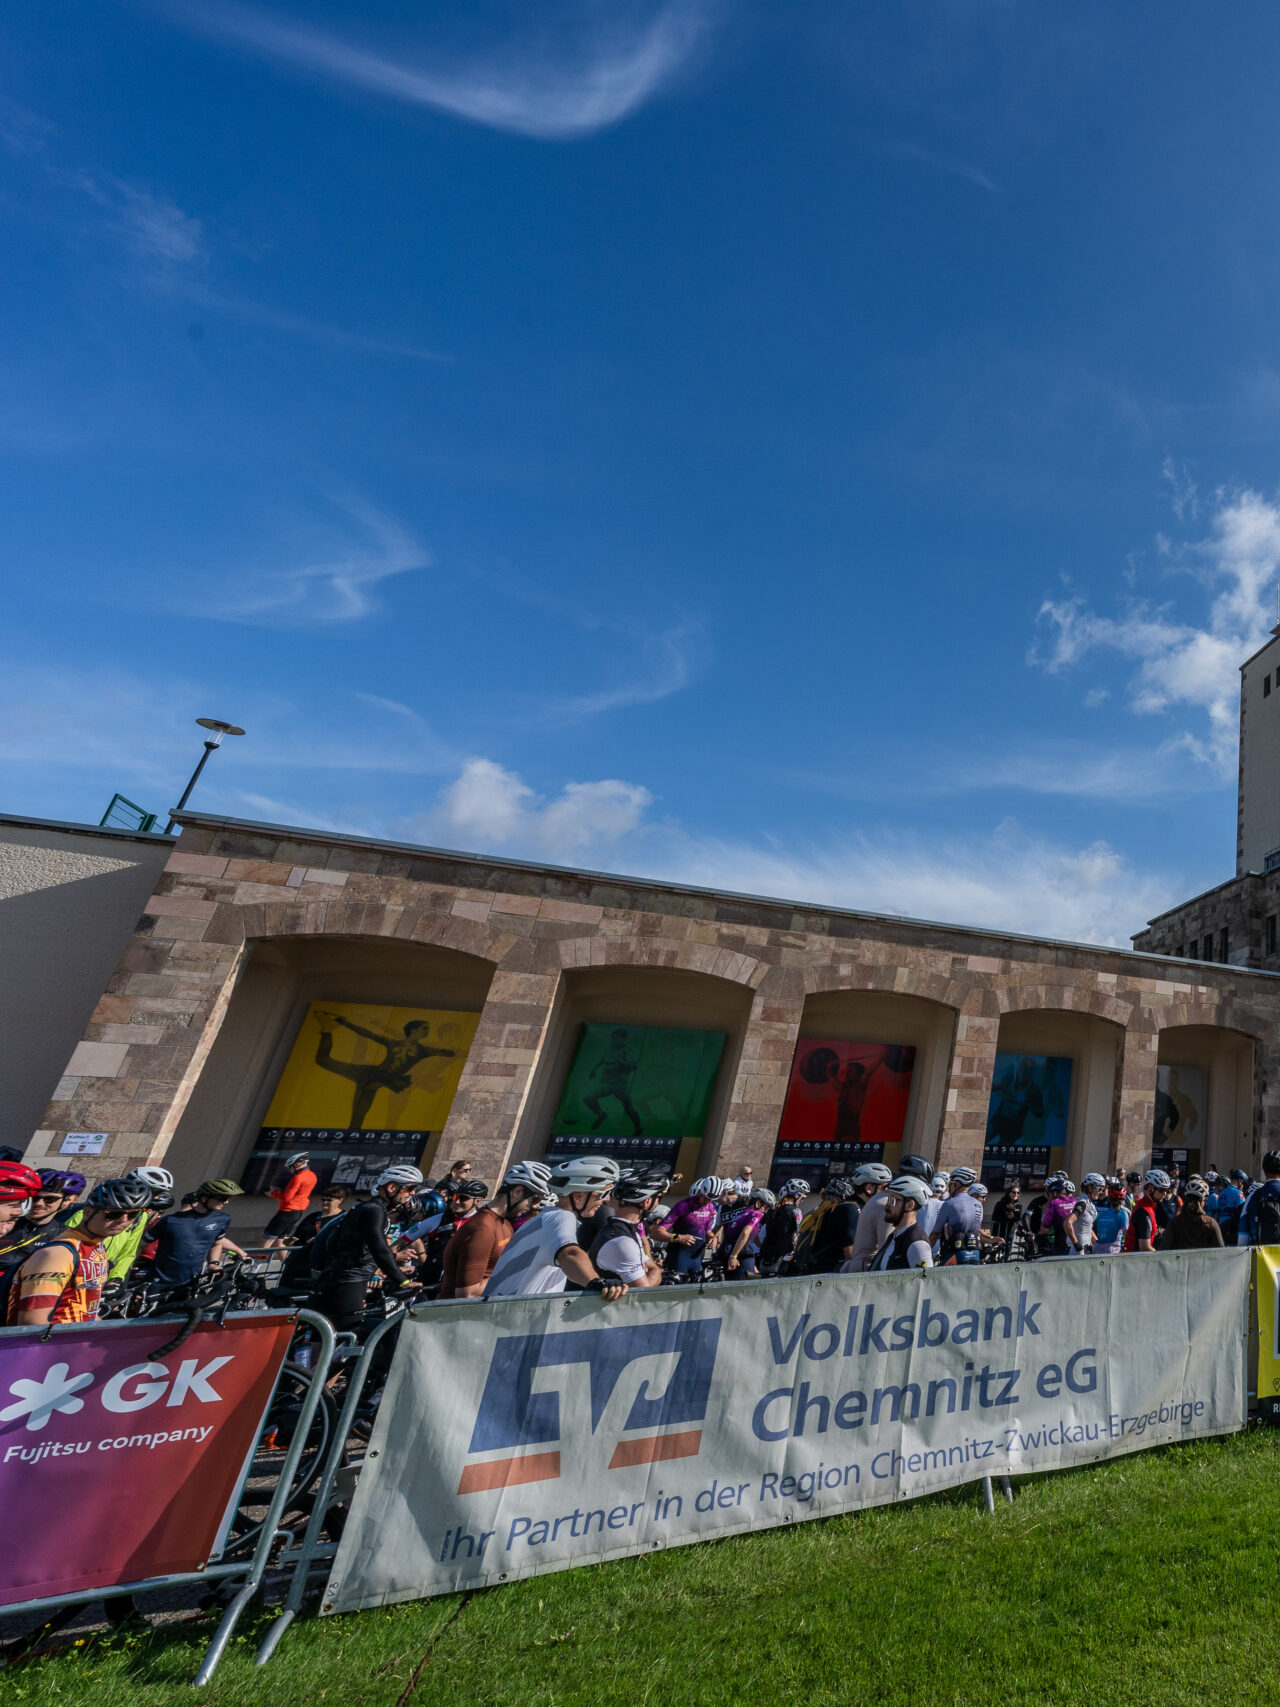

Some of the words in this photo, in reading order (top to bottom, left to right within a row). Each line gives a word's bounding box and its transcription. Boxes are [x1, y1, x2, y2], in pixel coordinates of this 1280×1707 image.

[766, 1290, 1043, 1366] Volksbank
[101, 1355, 236, 1414] GK
[751, 1360, 1021, 1443] Chemnitz
[1036, 1348, 1099, 1398] eG
[3, 1440, 93, 1465] Fujitsu
[97, 1425, 215, 1451] company
[439, 1525, 496, 1563] Ihr
[505, 1499, 646, 1551] Partner
[653, 1489, 682, 1521] in
[695, 1478, 750, 1514] der
[758, 1462, 861, 1506] Region
[870, 1397, 1205, 1480] Chemnitz-Zwickau-Erzgebirge
